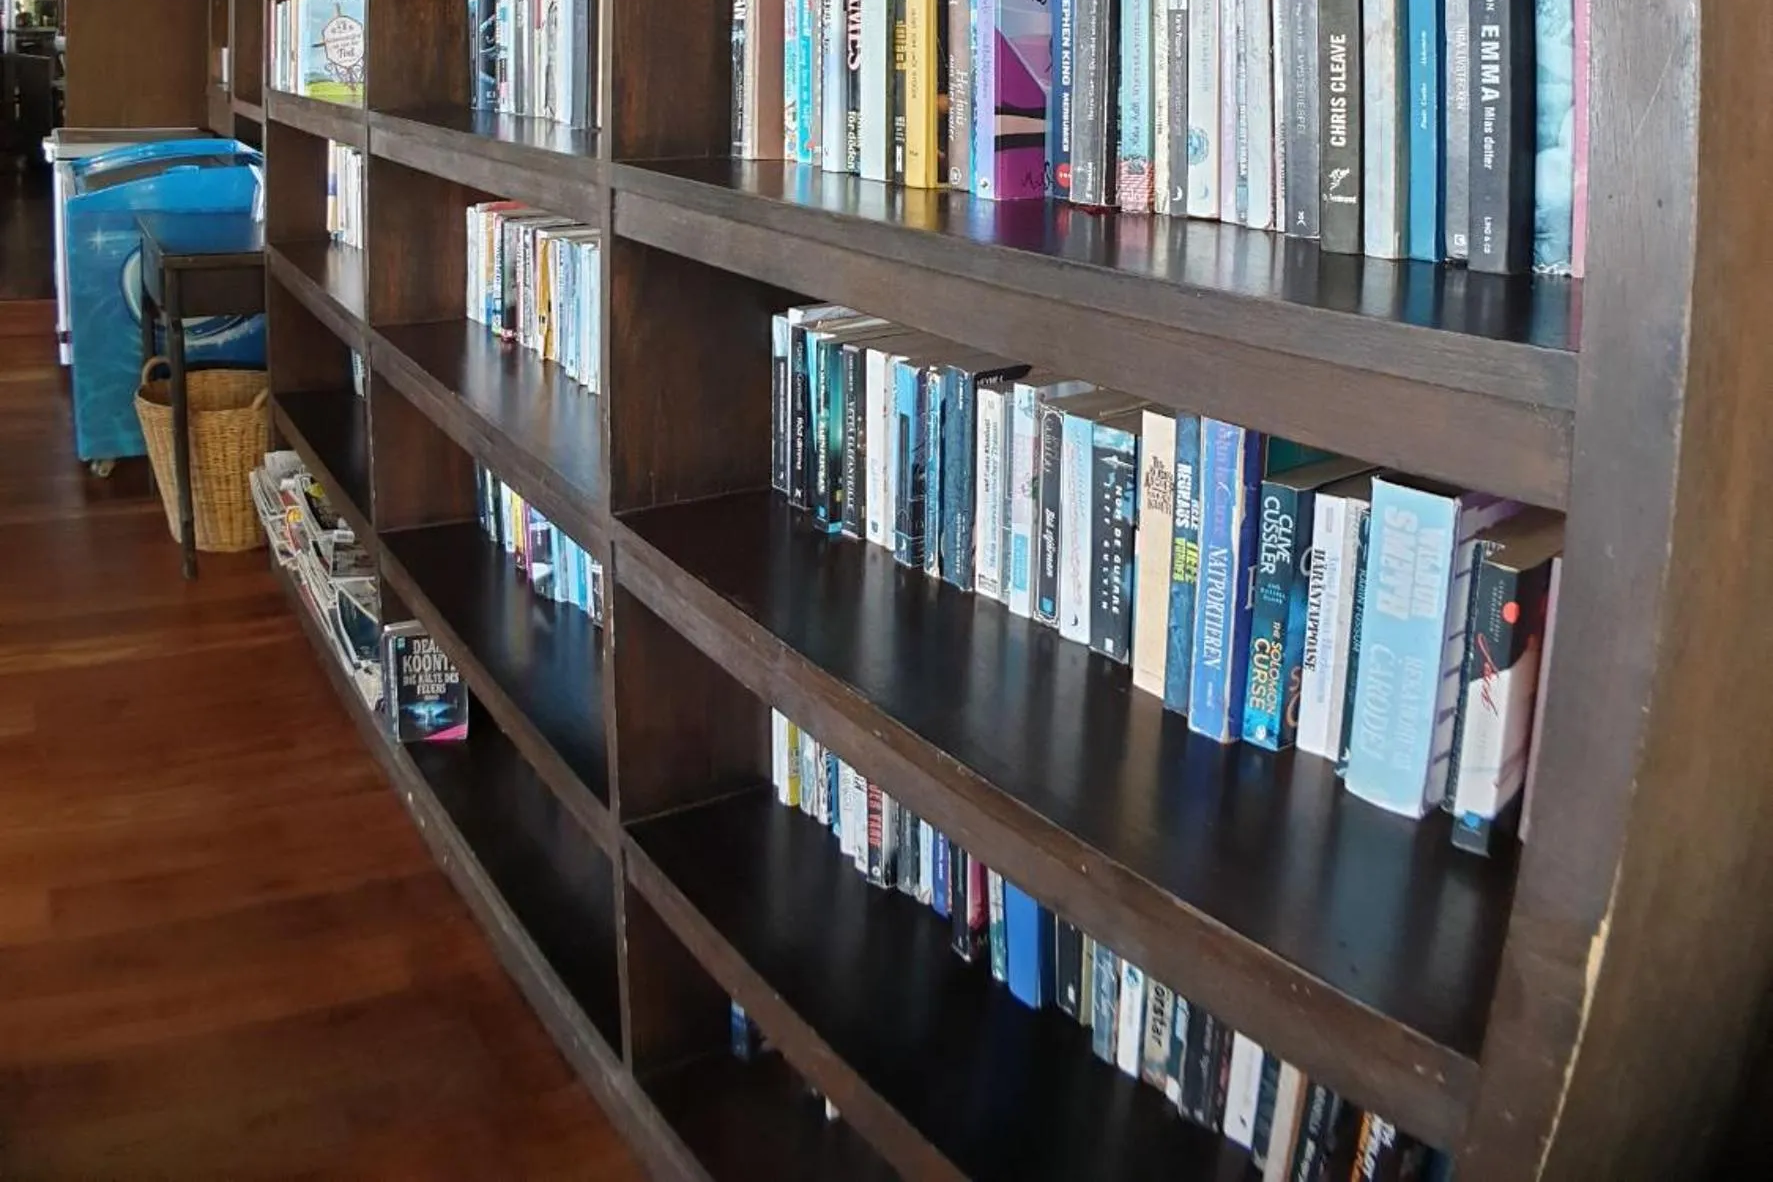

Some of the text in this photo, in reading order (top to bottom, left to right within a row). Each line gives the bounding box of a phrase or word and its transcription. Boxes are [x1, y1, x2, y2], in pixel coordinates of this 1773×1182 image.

[956, 71, 968, 127] Het huis
[1061, 50, 1071, 86] KING
[1329, 33, 1347, 148] CHRIS CLEAVE
[1480, 24, 1501, 171] EMMA Mias dotter
[846, 132, 857, 169] döden
[948, 106, 957, 141] water
[1175, 463, 1192, 528] NEUHAUS
[1111, 485, 1123, 615] NOM DE GUERRE
[1260, 495, 1281, 576] CUSSLER
[1275, 514, 1293, 565] CLIVE
[1376, 505, 1420, 622] SMITH
[413, 638, 443, 654] DEA
[1204, 545, 1228, 670] NATPORTIEREN
[1303, 547, 1326, 672] HÄRÄNTAPPOASE
[1353, 569, 1368, 653] KARIN FOSSUM
[445, 672, 460, 684] DES
[1251, 637, 1271, 710] CURSE
[1265, 621, 1284, 715] THE SOLOMON
